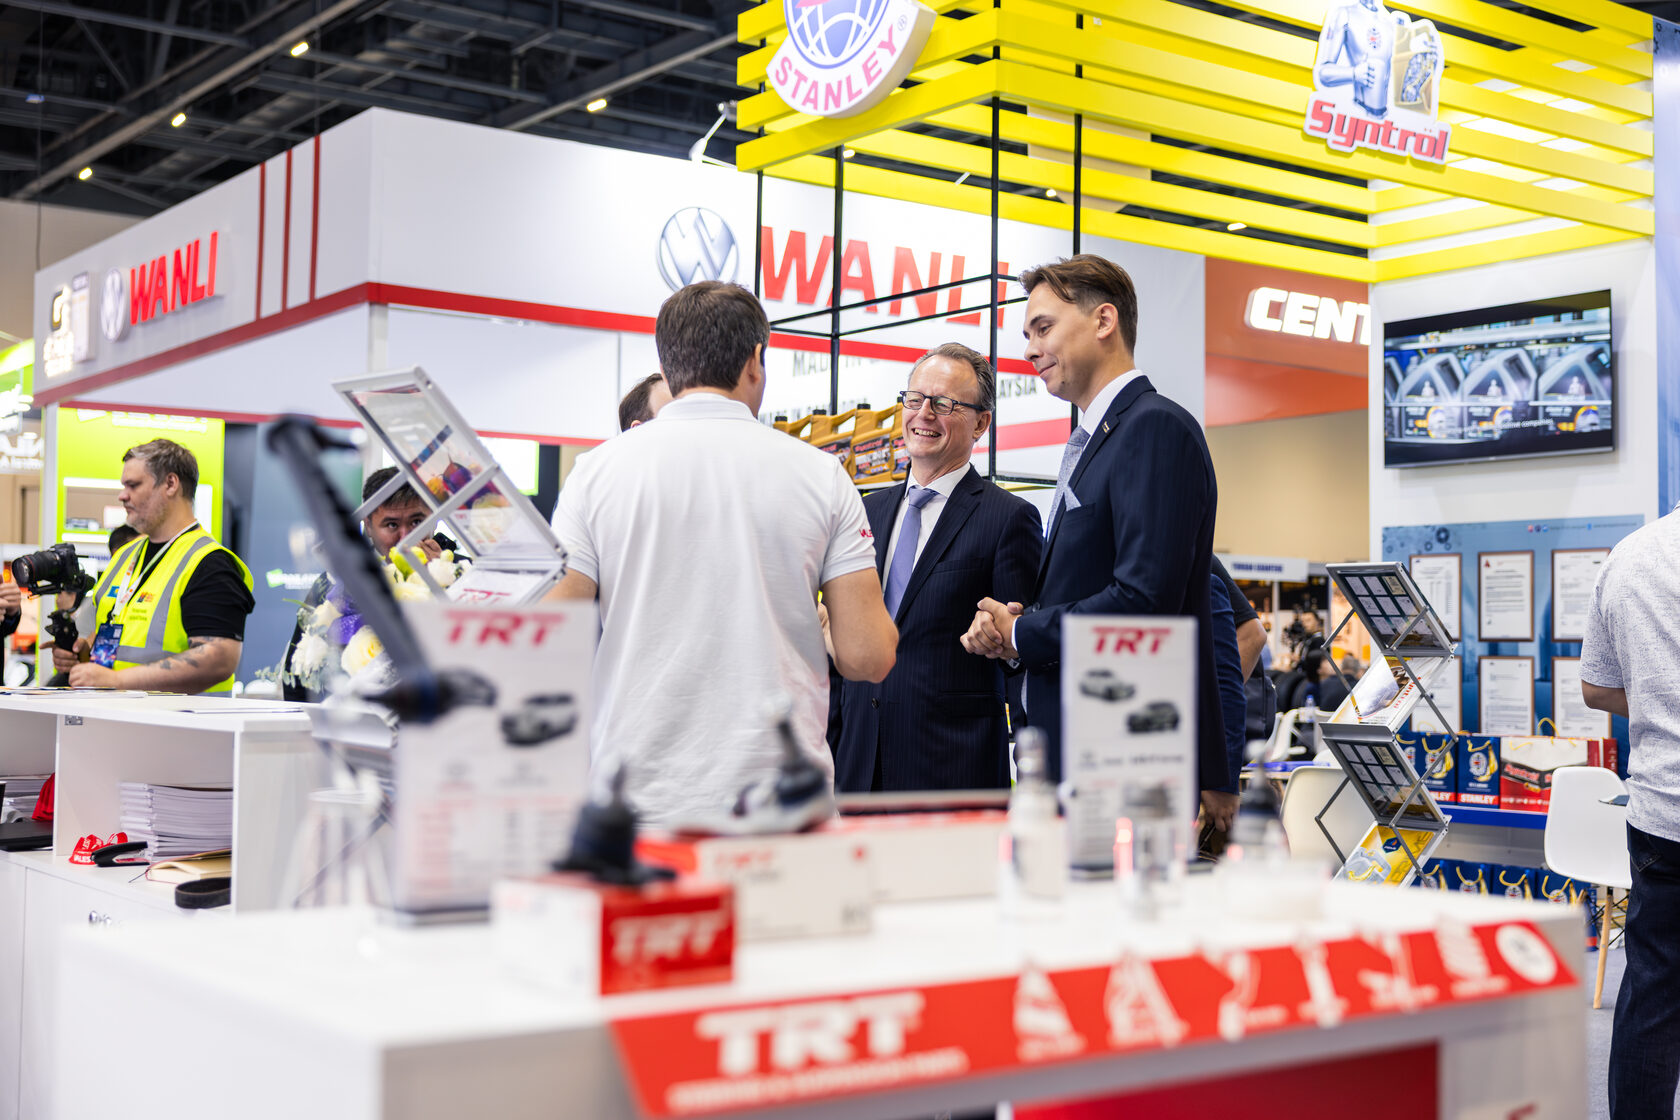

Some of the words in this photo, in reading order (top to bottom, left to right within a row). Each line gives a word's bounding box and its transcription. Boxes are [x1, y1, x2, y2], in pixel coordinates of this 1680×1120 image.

[775, 24, 897, 111] STANLEY
[129, 231, 219, 326] WANLI
[760, 225, 1010, 330] WANLI
[444, 609, 565, 648] TRT
[1091, 626, 1172, 655] TRT
[1461, 794, 1496, 805] STANLEY
[696, 990, 923, 1076] TRT
